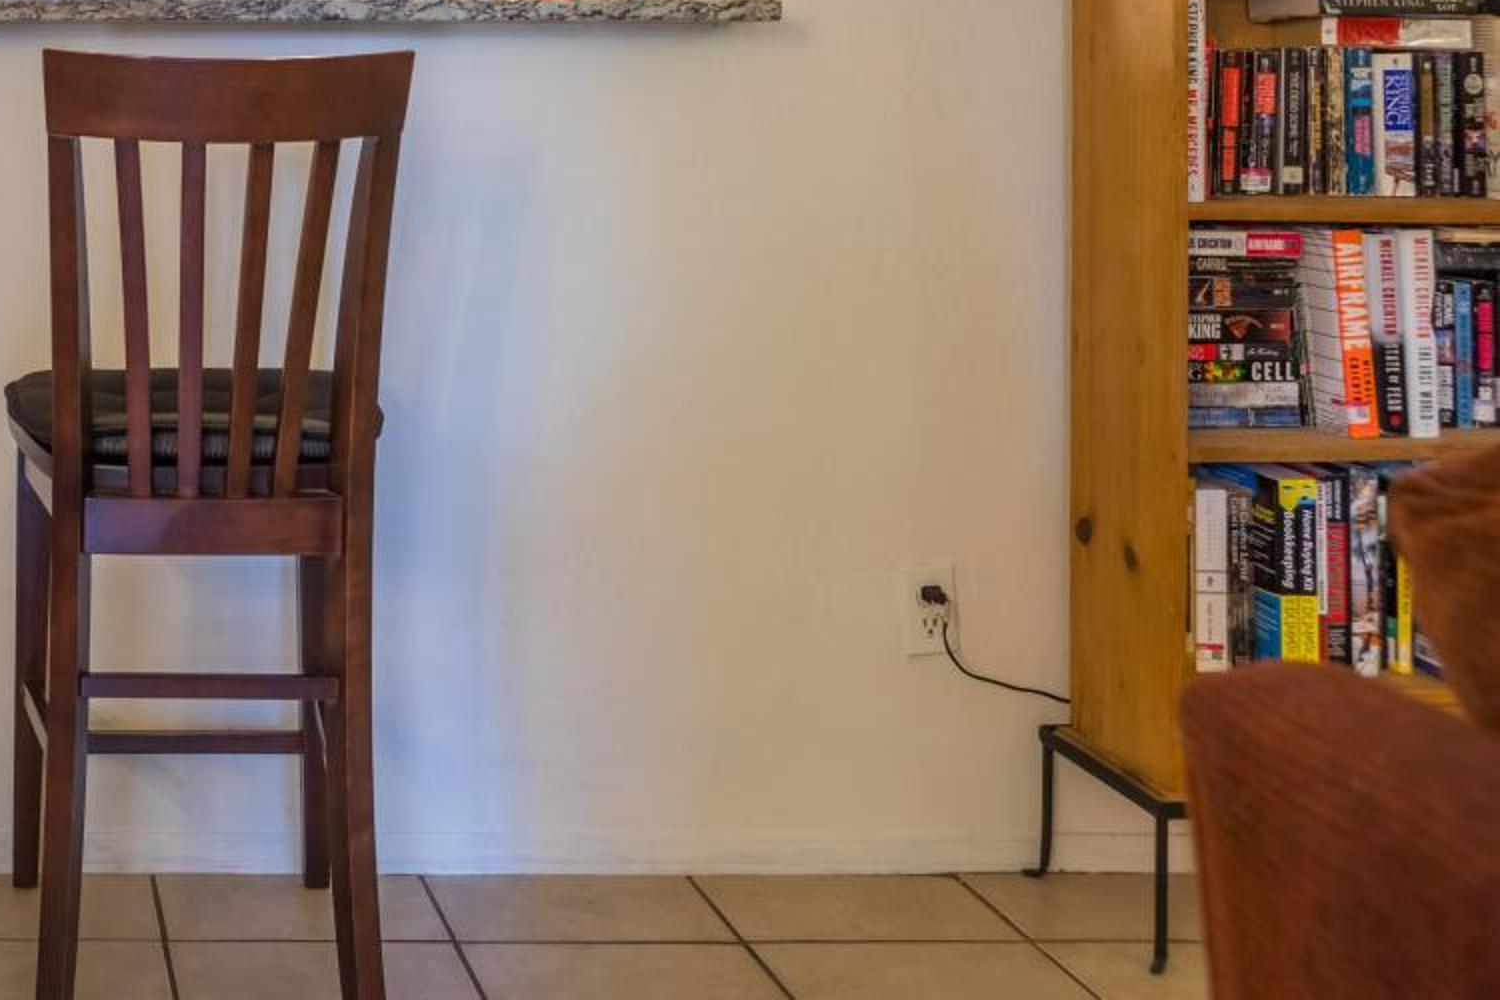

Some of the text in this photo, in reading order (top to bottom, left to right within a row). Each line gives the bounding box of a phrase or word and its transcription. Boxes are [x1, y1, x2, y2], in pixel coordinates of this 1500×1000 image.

[1385, 75, 1400, 126] KING
[1335, 242, 1370, 350] AIRFRAME
[1379, 239, 1397, 336] MICHAEL CRICHTON
[1414, 237, 1431, 338] MICHAEL CRICHTON
[1188, 322, 1222, 340] KING
[1251, 361, 1295, 381] CELL
[1384, 343, 1400, 373] STATE
[1418, 347, 1432, 361] THE
[1386, 387, 1403, 412] FEAR
[1419, 390, 1434, 421] WORLD
[1281, 511, 1296, 589] Bookkeeping
[1300, 509, 1314, 591] Home Buying Kit
